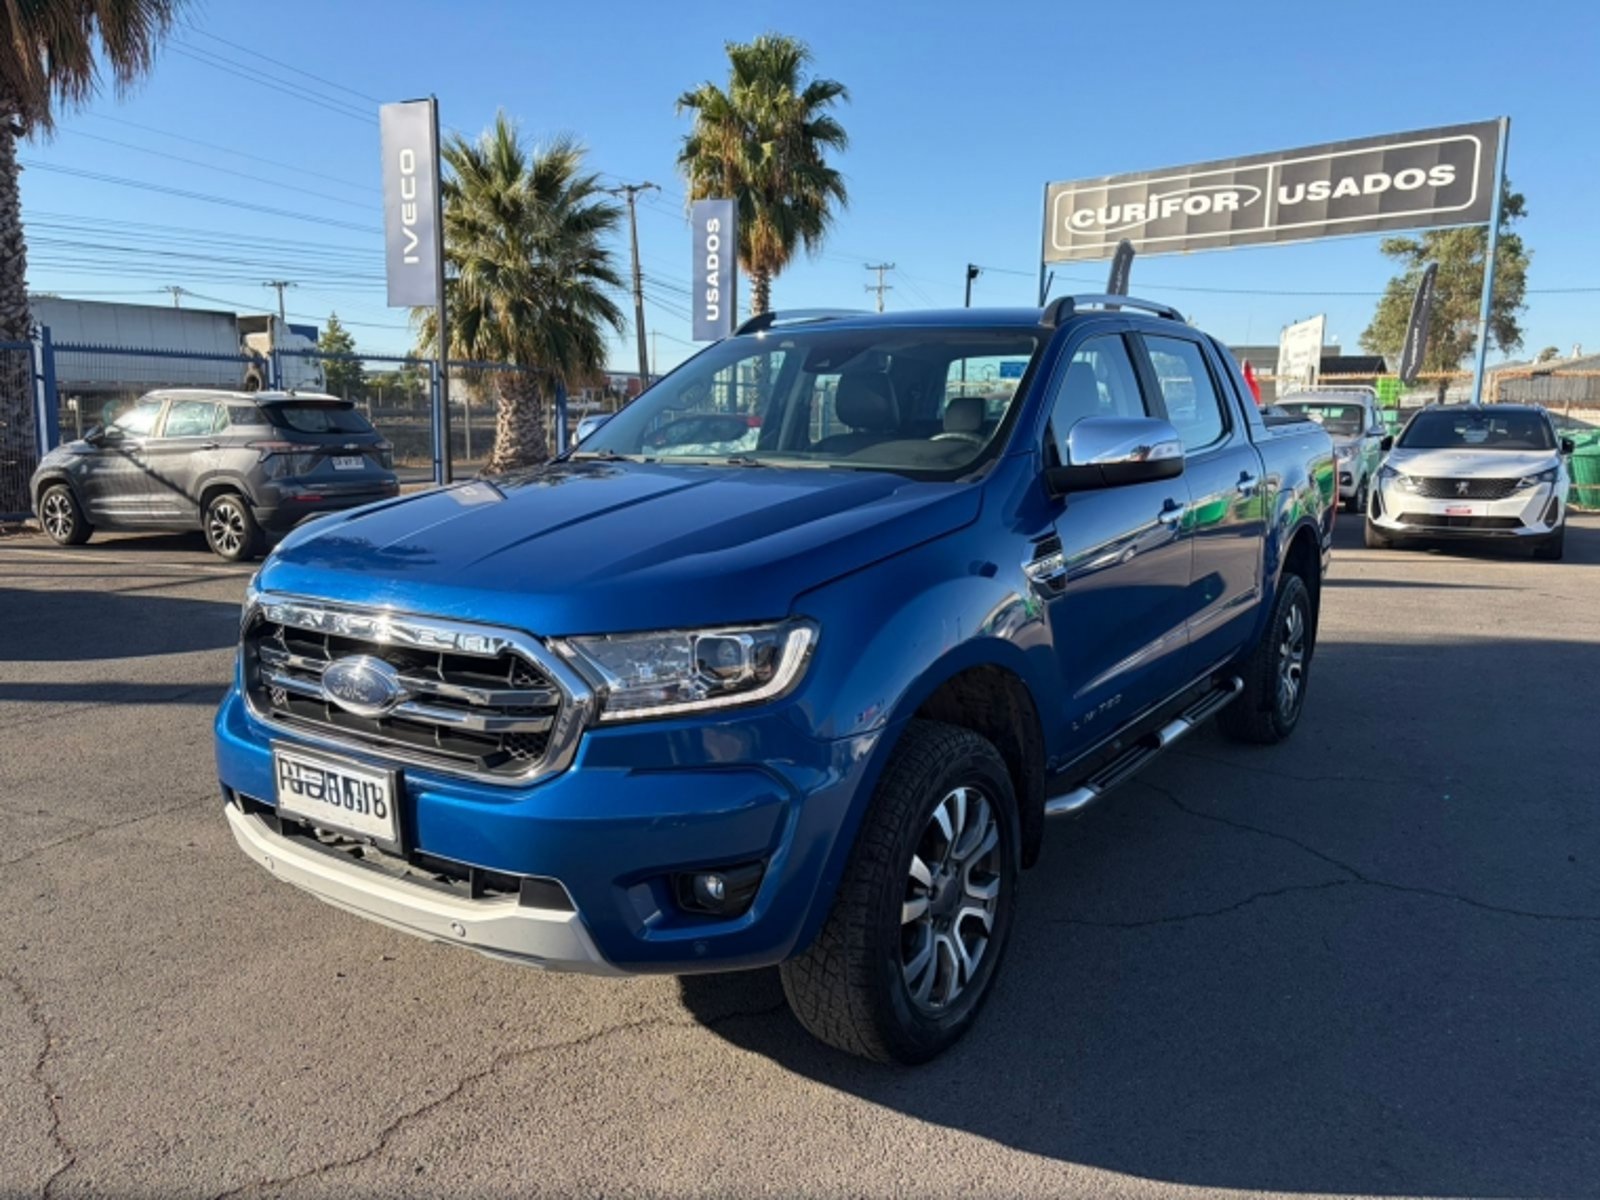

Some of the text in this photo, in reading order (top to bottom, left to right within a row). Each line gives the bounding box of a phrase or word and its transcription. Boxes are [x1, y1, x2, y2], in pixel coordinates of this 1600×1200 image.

[400, 149, 419, 264] IVECO
[1278, 164, 1456, 205] USADOS
[706, 218, 721, 321] USADOS
